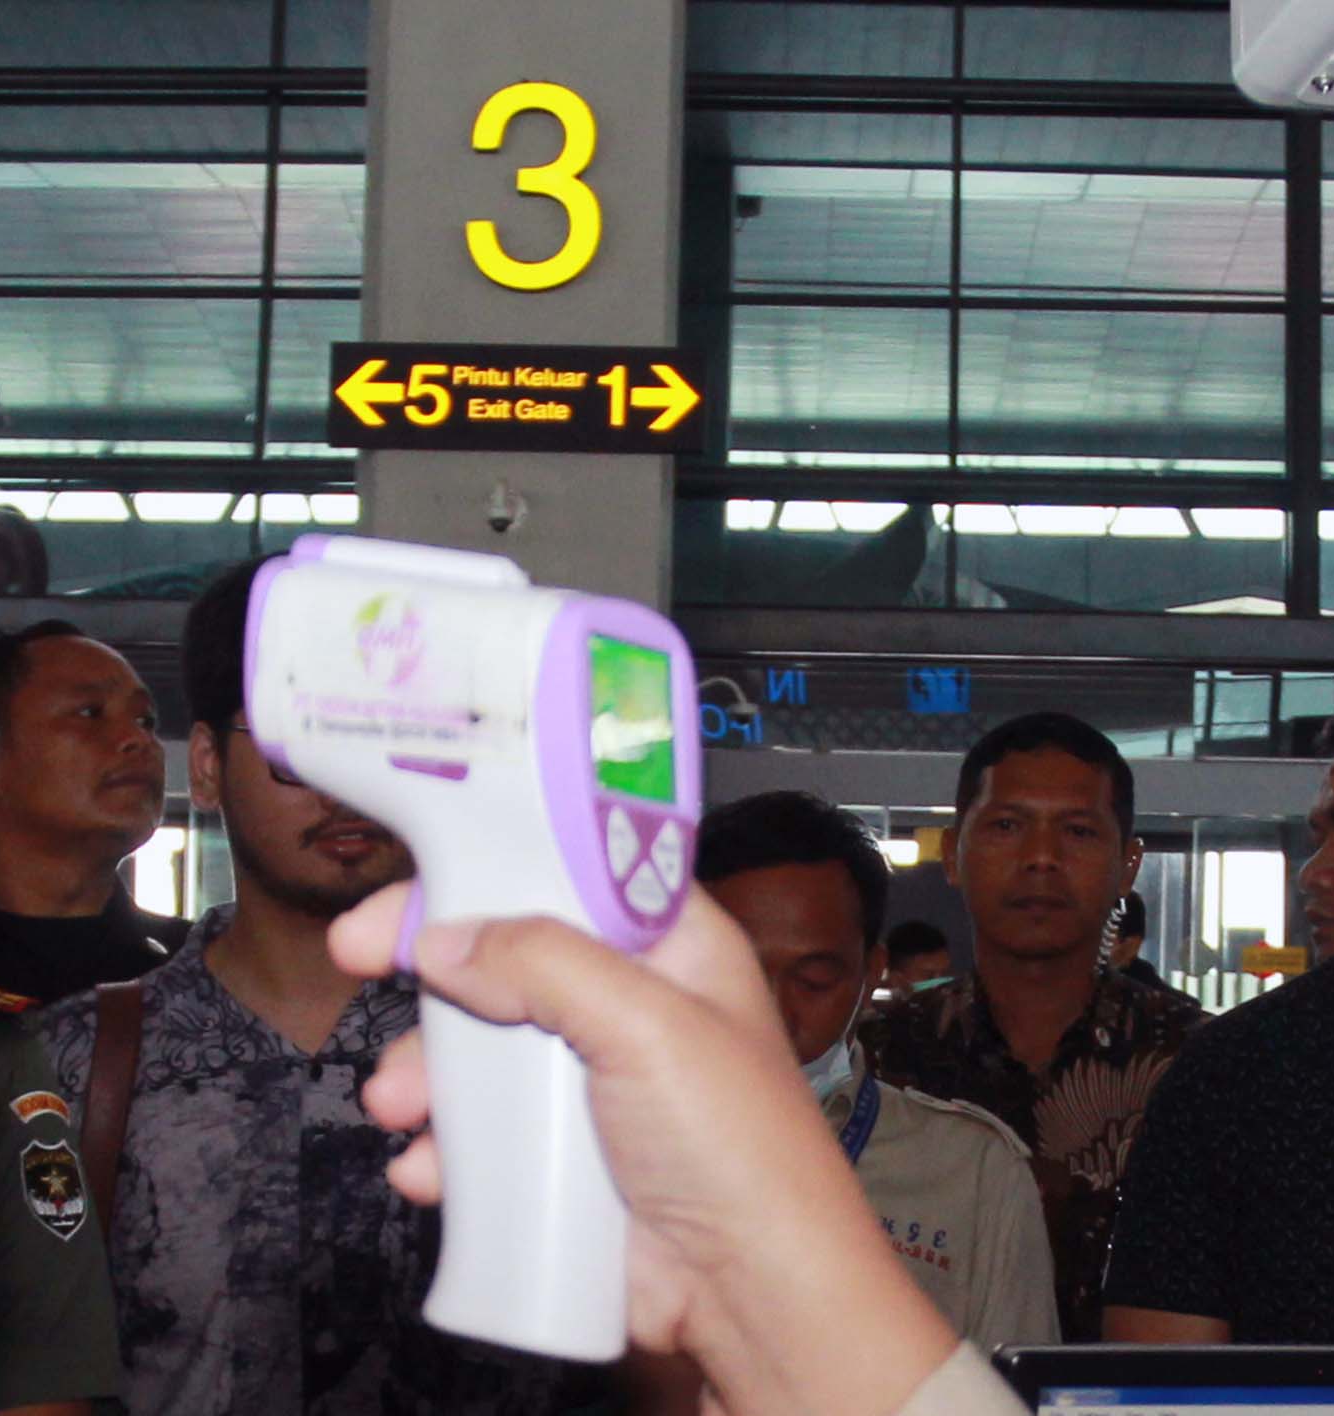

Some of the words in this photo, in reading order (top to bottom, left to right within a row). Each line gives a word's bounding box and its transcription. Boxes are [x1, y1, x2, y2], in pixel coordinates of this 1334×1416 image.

[465, 82, 603, 291] 3
[404, 364, 452, 426] 5
[452, 365, 509, 388] Pintu
[511, 368, 588, 390] Keluar
[597, 366, 627, 427] 1
[467, 398, 511, 420] Exit
[513, 399, 572, 422] Gate
